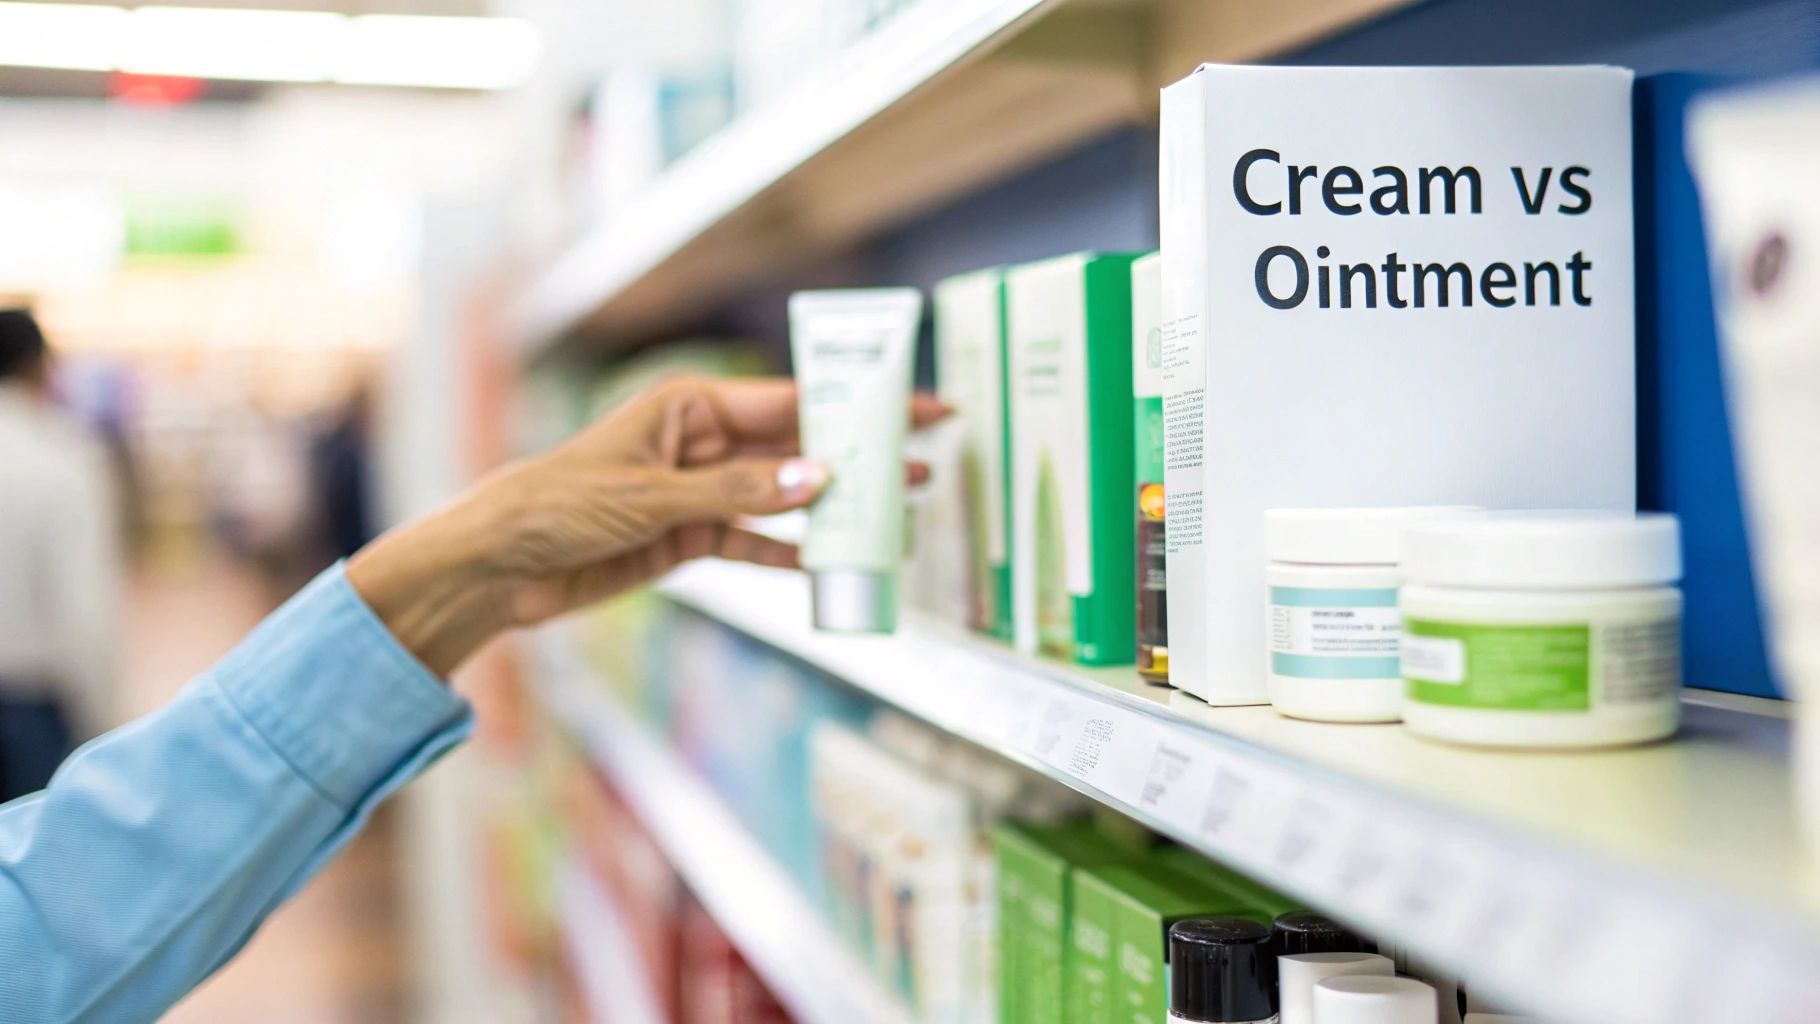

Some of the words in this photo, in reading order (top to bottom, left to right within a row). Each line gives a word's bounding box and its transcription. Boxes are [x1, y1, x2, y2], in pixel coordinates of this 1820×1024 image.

[1232, 148, 1482, 216] Cream
[1510, 164, 1593, 216] vs
[1254, 245, 1593, 310] Ointment
